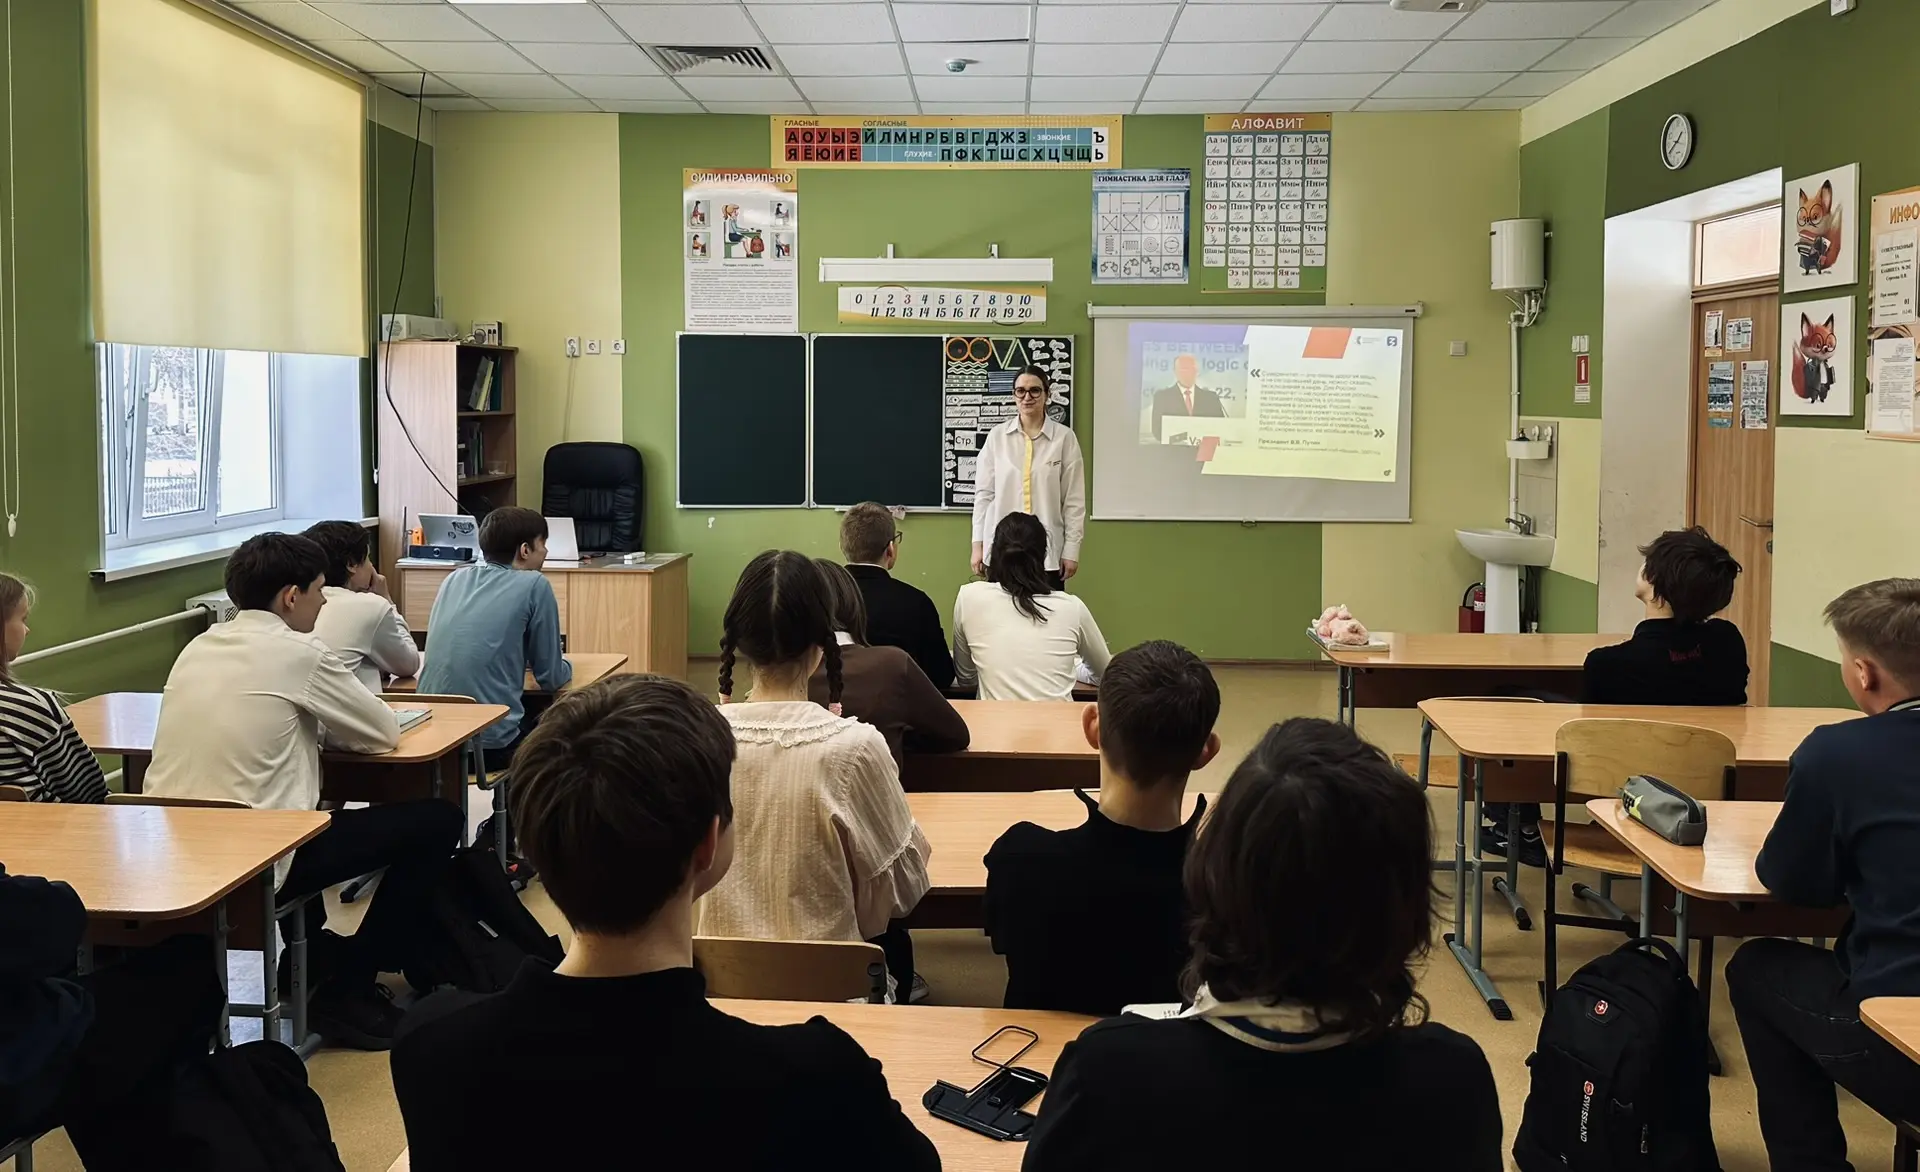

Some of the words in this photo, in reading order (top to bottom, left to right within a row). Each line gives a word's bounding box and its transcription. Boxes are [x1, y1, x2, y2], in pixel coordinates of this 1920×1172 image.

[1231, 118, 1304, 129] АЛФАВИТ
[691, 173, 722, 183] СИДИ
[725, 173, 792, 183] ПРАВИЛЬНО
[1890, 203, 1920, 224] ИНФО
[855, 294, 862, 305] 0
[872, 294, 877, 305] 1
[887, 294, 894, 305] 2
[904, 294, 911, 305] 3
[921, 294, 928, 305] 4
[938, 294, 945, 305] 5
[955, 294, 962, 305] 6
[972, 294, 979, 305] 7
[989, 294, 995, 305] 8
[1006, 294, 1013, 305] 9
[1019, 294, 1031, 305] 10
[870, 307, 879, 318] 11
[885, 307, 895, 318] 12
[902, 307, 913, 318] 13
[919, 307, 929, 318] 14
[935, 307, 946, 318] 15
[952, 307, 963, 318] 16
[969, 307, 980, 318] 17
[986, 307, 997, 318] 18
[1003, 307, 1014, 318] 19
[1018, 307, 1032, 318] 20
[956, 436, 973, 446] Стр.
[1580, 1095, 1590, 1142] SWISSLAND
